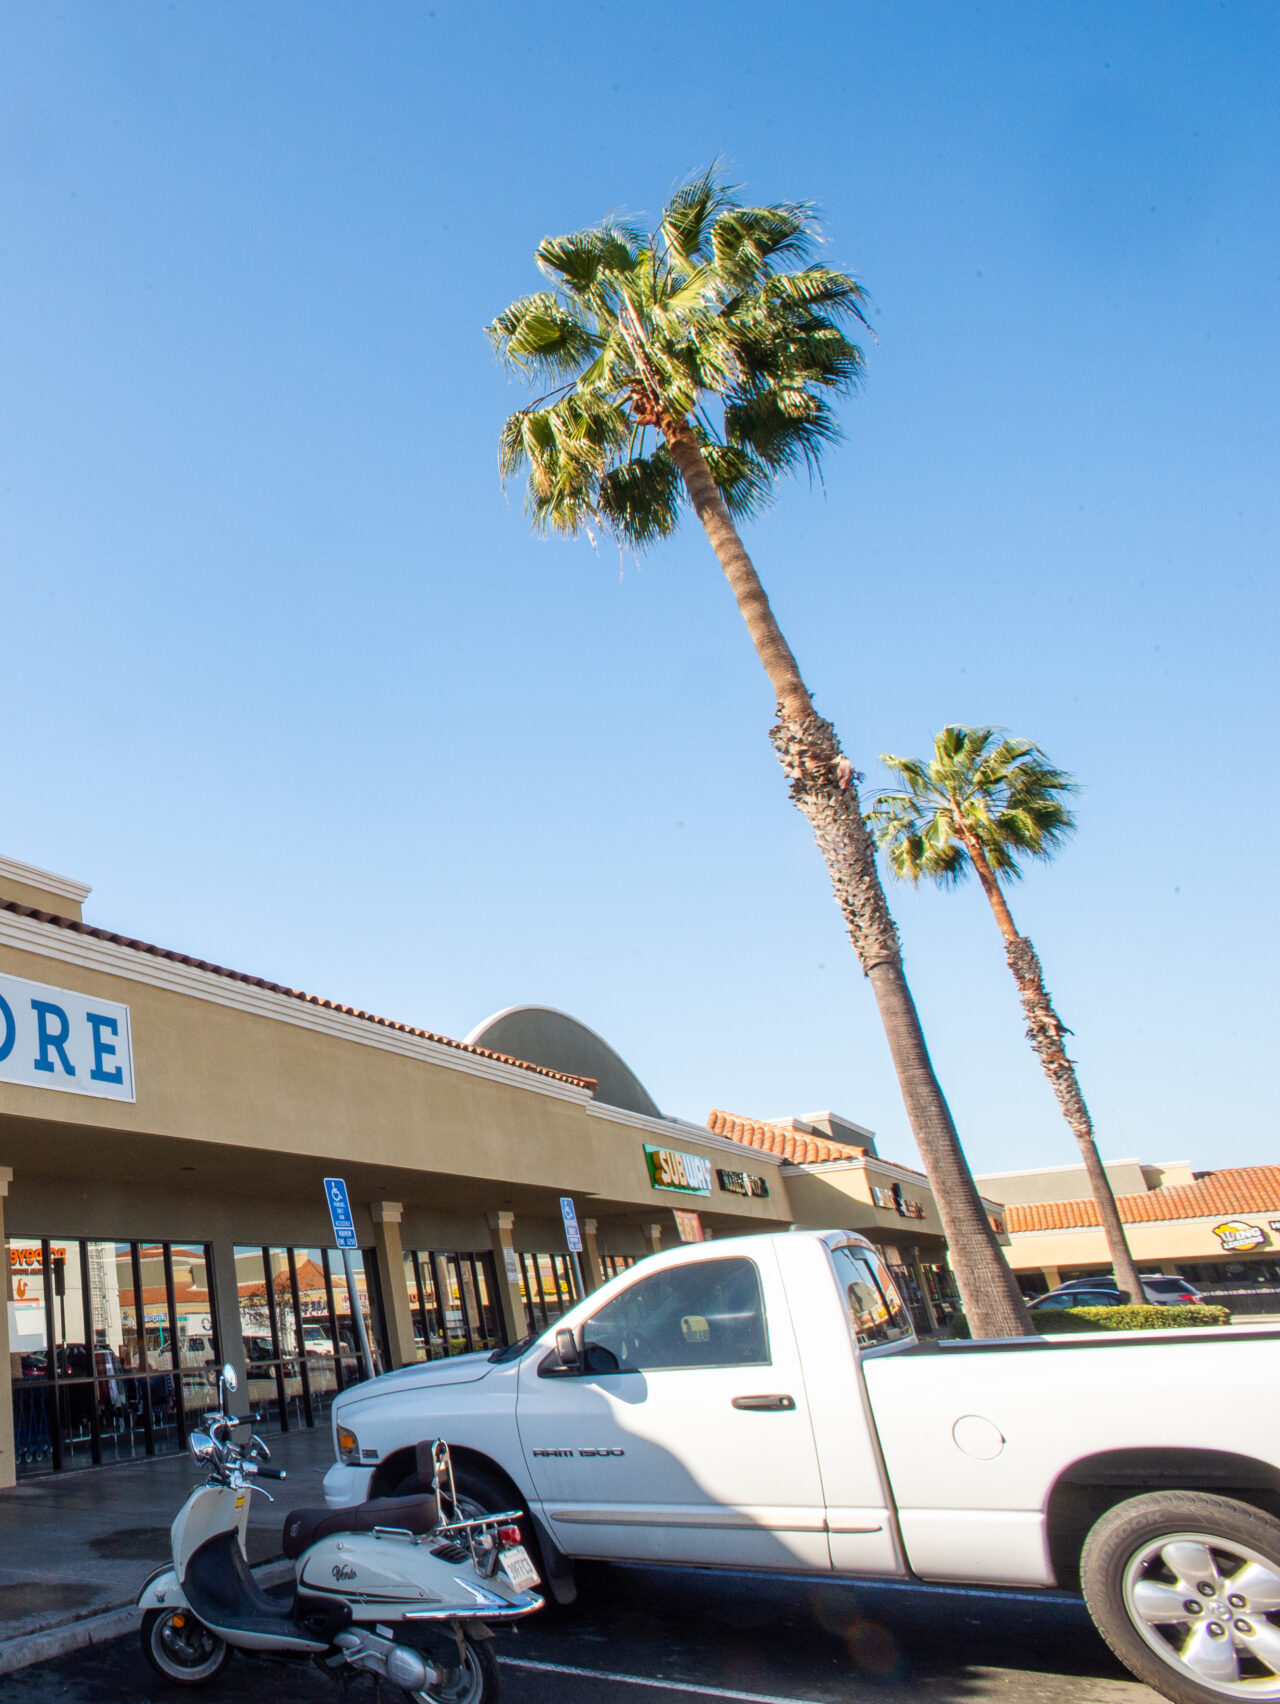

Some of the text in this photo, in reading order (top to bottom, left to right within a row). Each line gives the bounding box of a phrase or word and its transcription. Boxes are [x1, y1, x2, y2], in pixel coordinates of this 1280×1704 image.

[652, 1150, 712, 1190] SUBWAY
[1220, 1227, 1262, 1242] WING
[532, 1448, 625, 1457] RAM 1500
[331, 1563, 357, 1582] Vento
